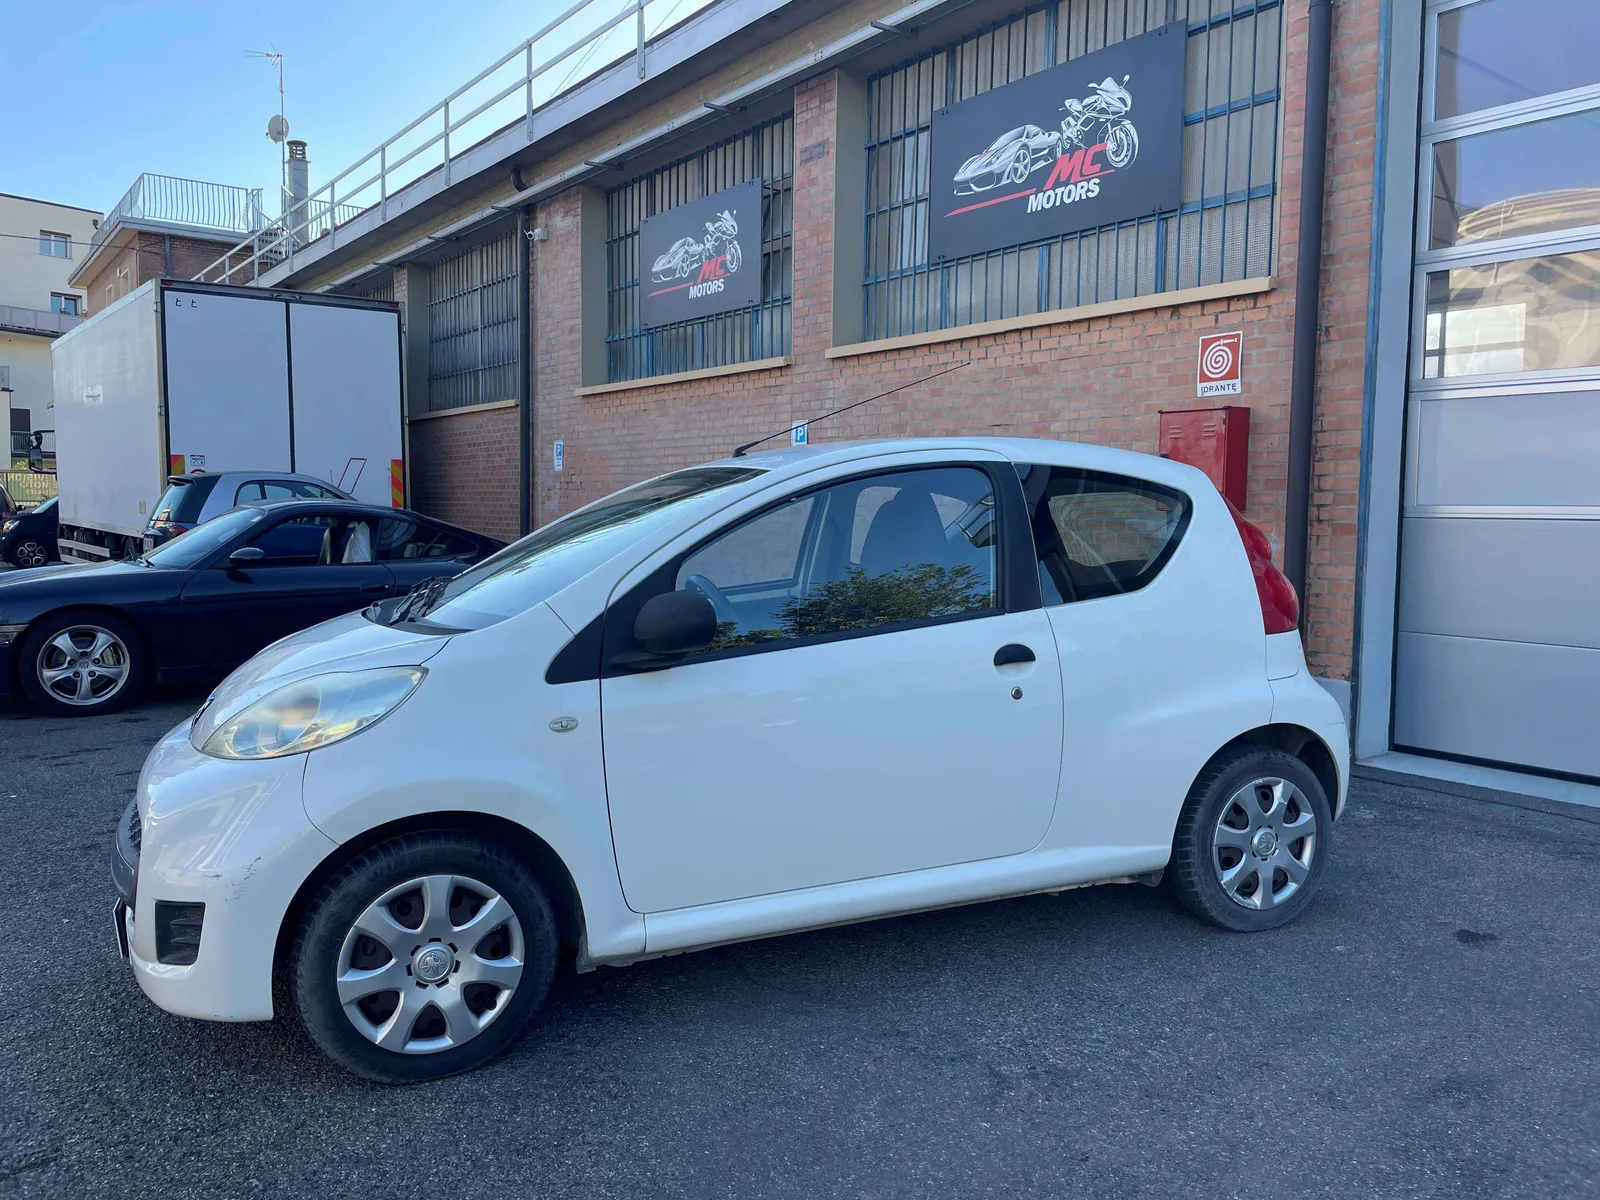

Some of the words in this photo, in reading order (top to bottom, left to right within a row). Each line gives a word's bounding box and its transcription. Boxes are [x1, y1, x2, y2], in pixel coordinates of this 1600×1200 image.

[1043, 142, 1109, 190] MC
[1027, 178, 1100, 214] MOTORS
[697, 255, 727, 284] MC
[689, 278, 725, 299] MOTORS
[1201, 382, 1237, 394] IDRANTE
[797, 427, 804, 441] P
